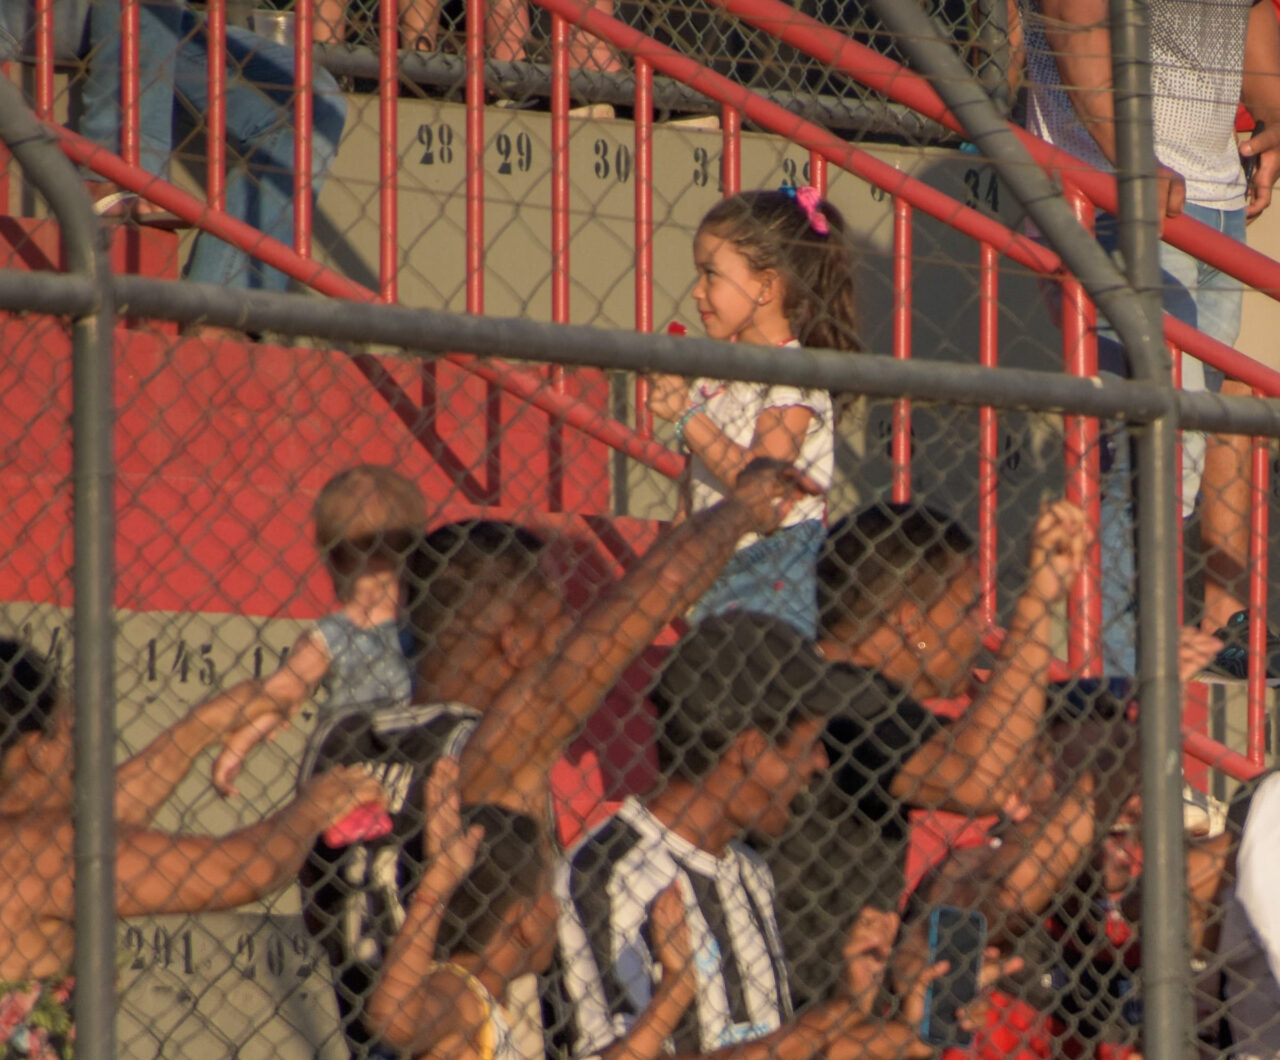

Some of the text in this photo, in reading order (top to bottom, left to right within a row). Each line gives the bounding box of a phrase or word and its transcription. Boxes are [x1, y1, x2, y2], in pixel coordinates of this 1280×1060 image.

[418, 124, 453, 165] 28
[496, 132, 532, 174] 29
[594, 139, 630, 182] 30
[693, 147, 724, 192] 3
[147, 638, 214, 685] 145
